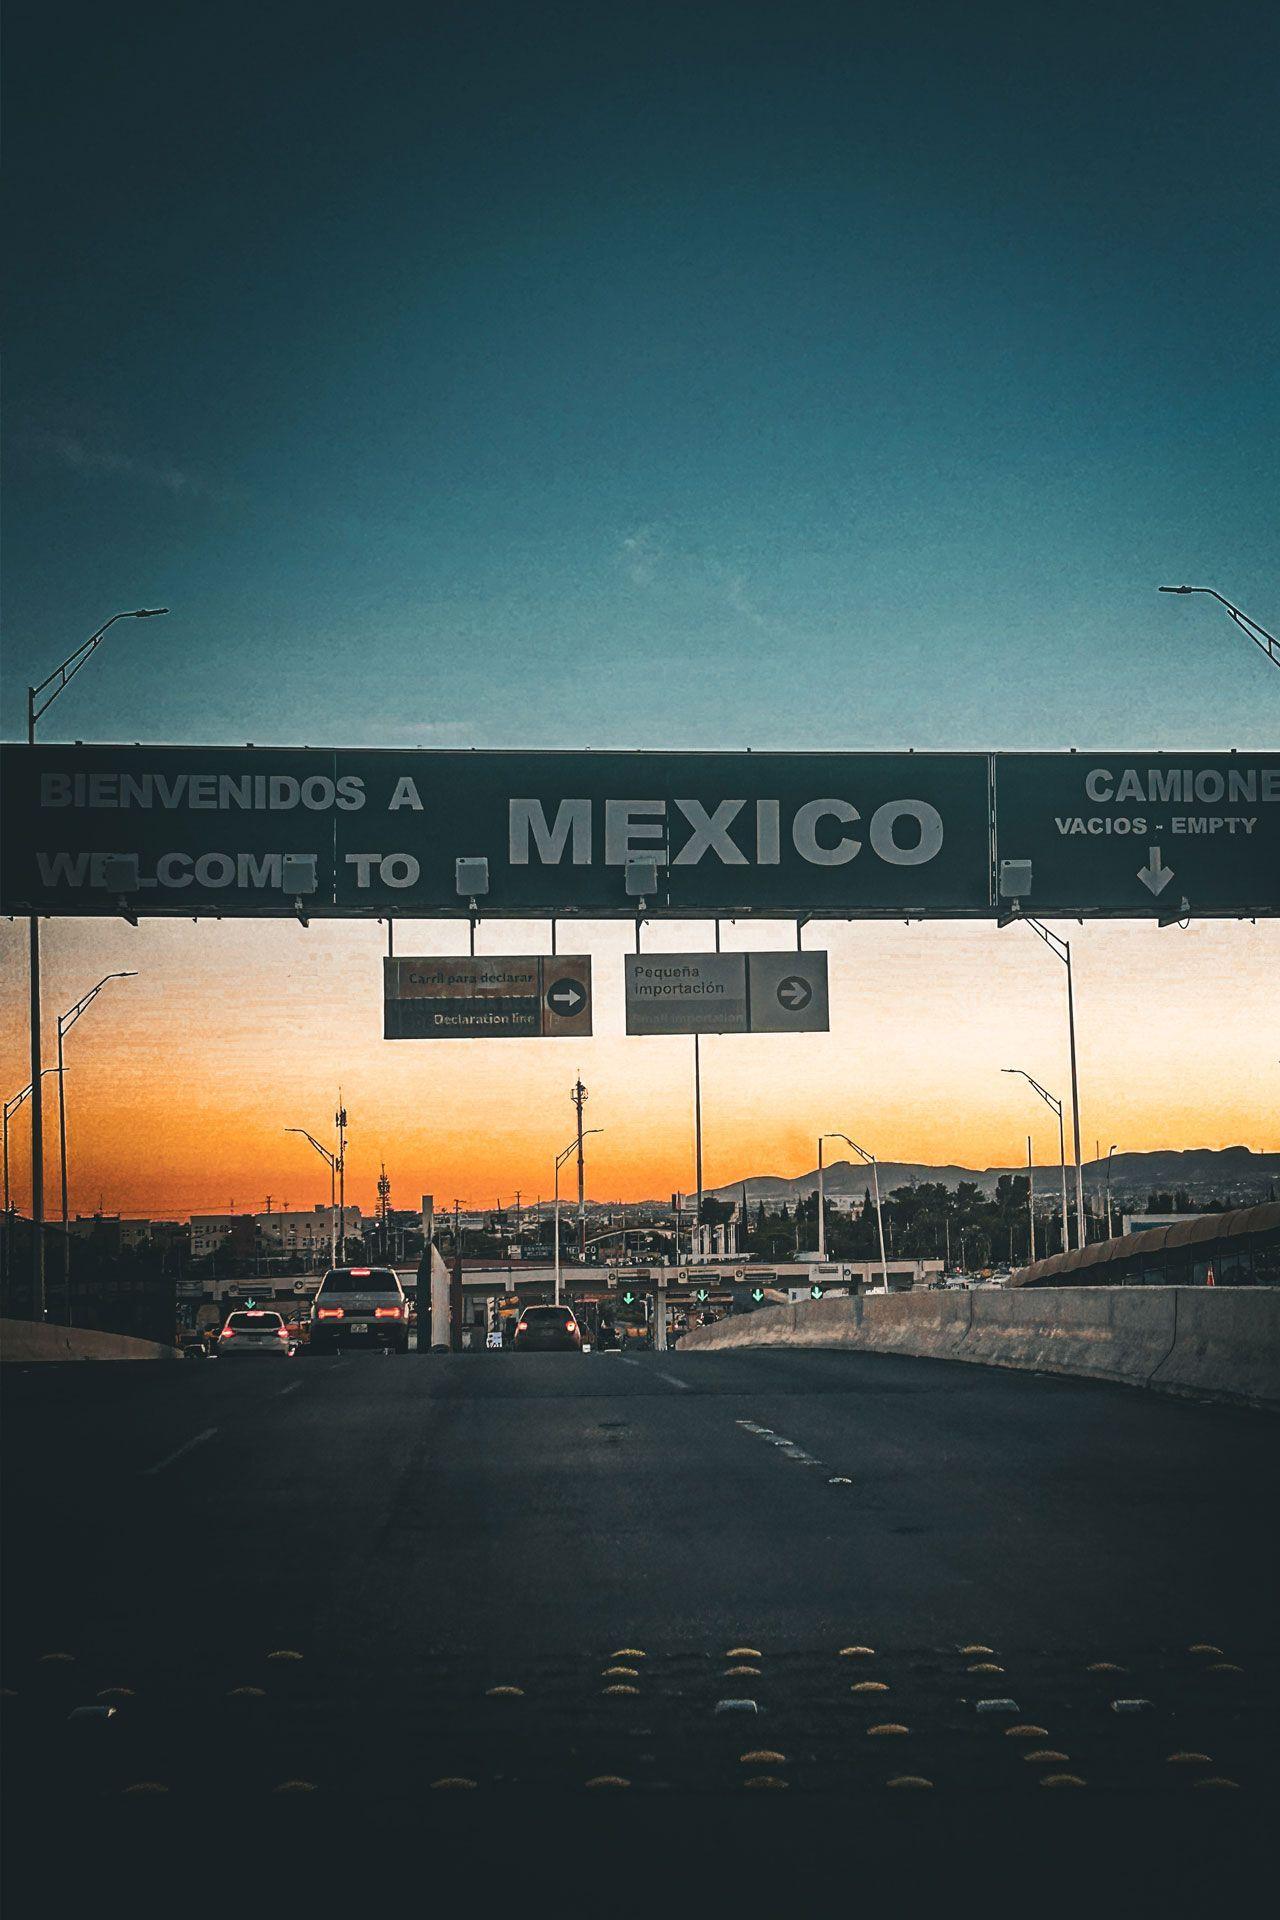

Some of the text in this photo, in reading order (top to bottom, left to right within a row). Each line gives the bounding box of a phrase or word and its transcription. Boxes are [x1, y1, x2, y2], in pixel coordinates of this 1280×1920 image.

[40, 773, 424, 811] BIENVENIDOS A
[508, 798, 944, 866] MEXICO
[1055, 817, 1148, 835] VACIOS
[1171, 817, 1257, 835] EMPTY
[345, 853, 420, 888] TO
[447, 975, 477, 986] para
[480, 972, 533, 984] declarar
[634, 966, 699, 980] Pequeña
[634, 981, 724, 997] importación
[433, 1012, 535, 1025] Declaration line
